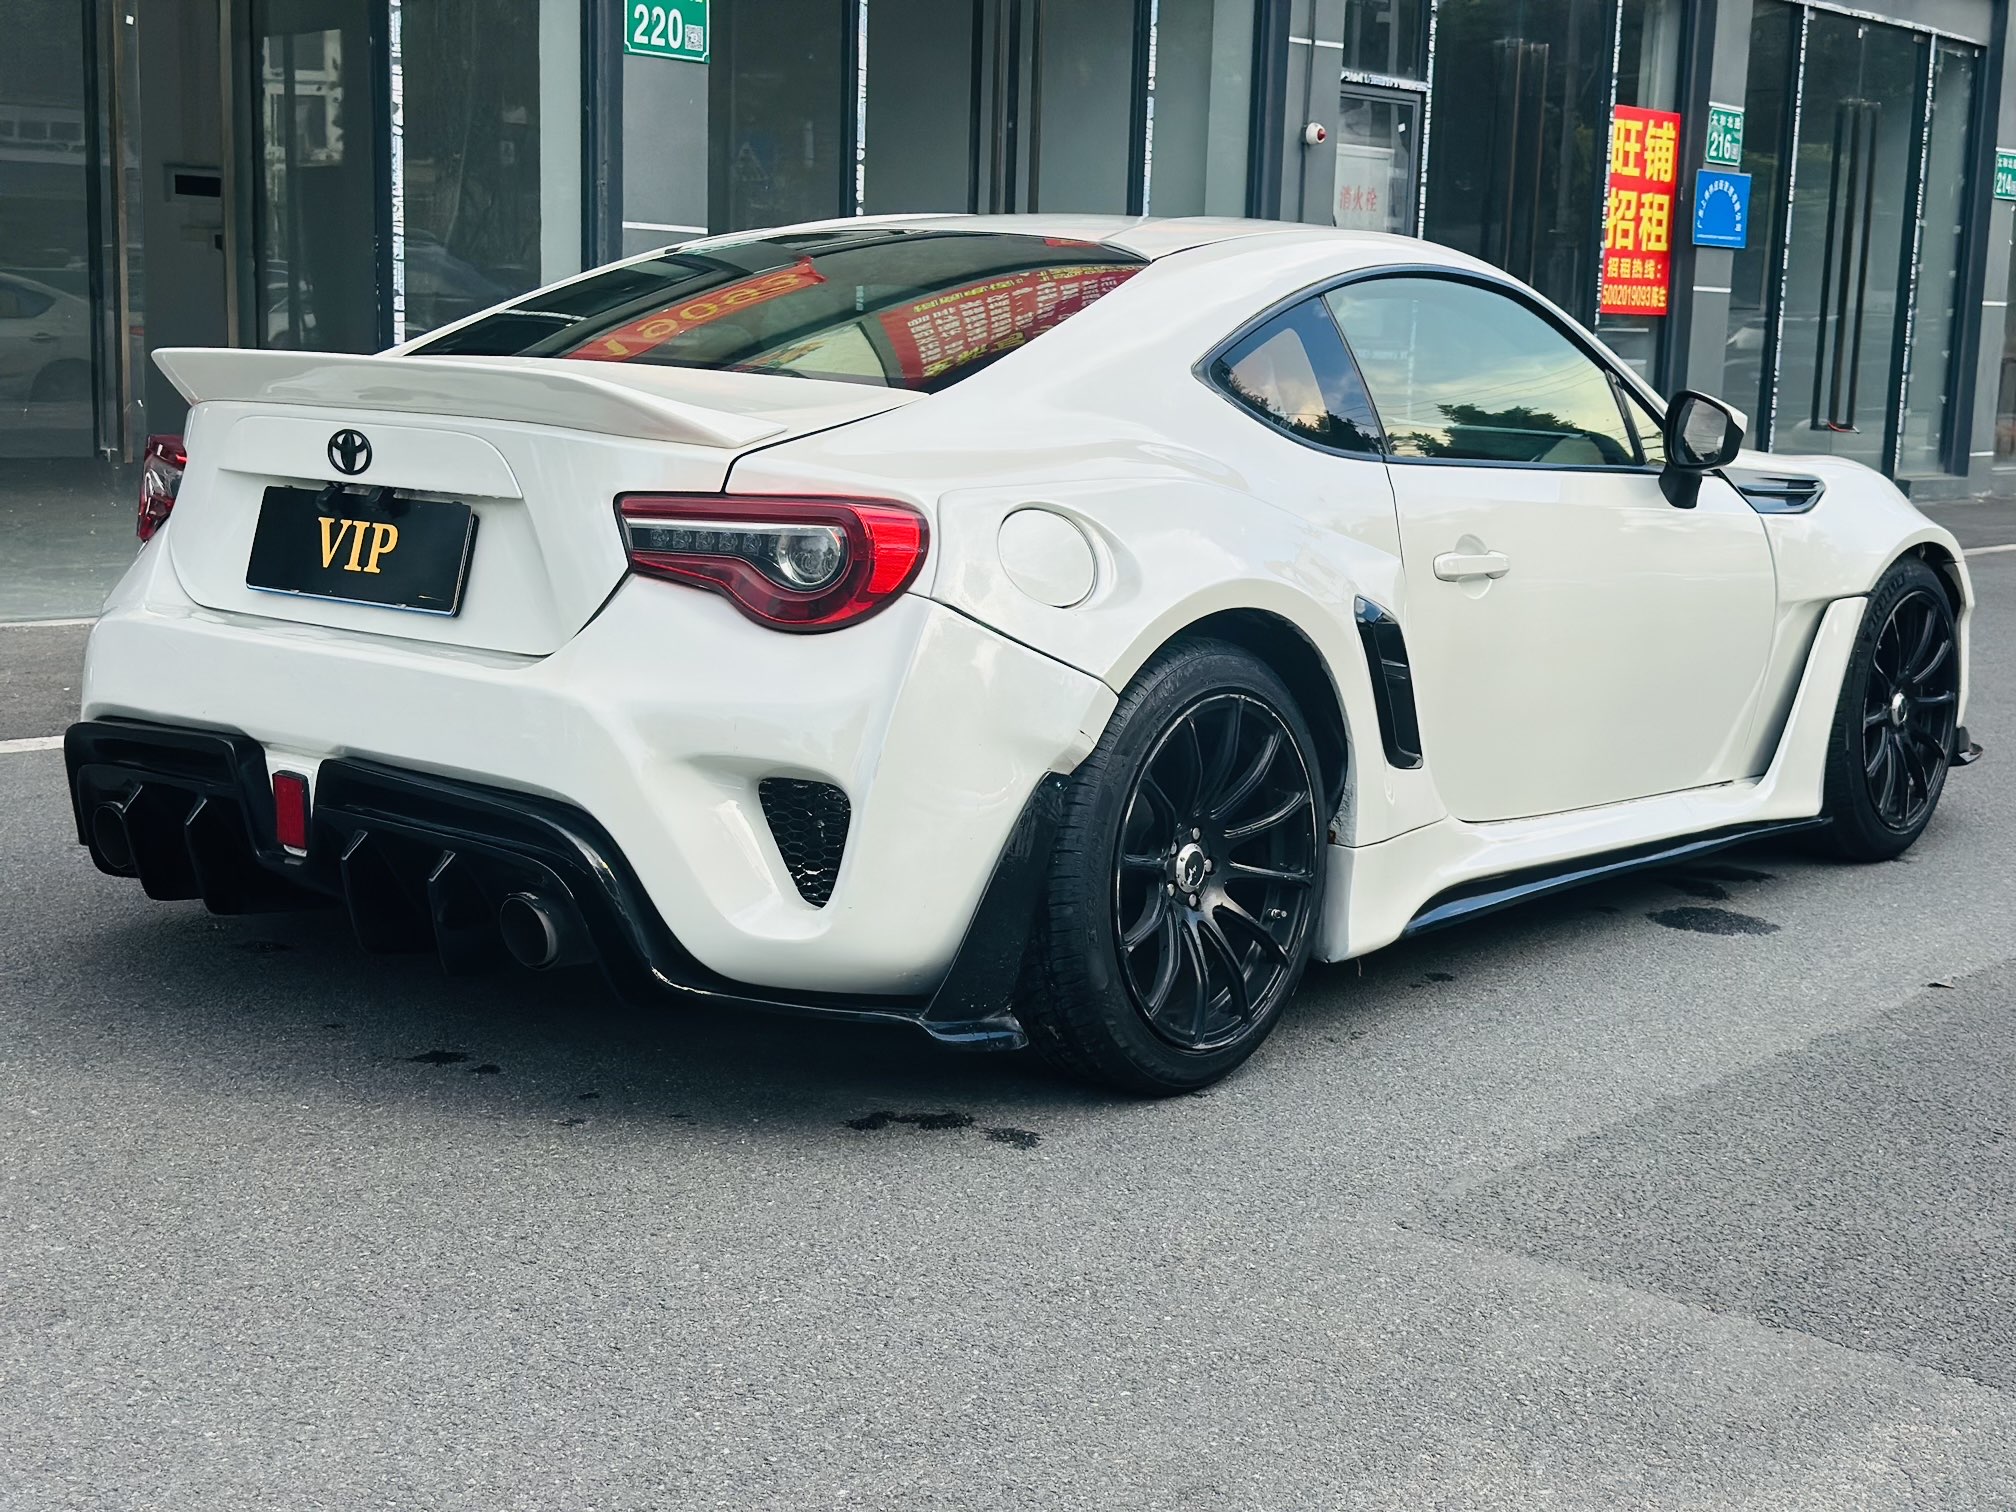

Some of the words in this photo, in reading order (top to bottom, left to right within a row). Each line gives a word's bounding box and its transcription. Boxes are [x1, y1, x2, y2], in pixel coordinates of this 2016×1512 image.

[633, 3, 683, 49] 220
[1610, 118, 1676, 182] 旺铺
[1709, 131, 1732, 159] 216
[1340, 185, 1376, 211] 消火栓
[1996, 172, 2012, 194] 214
[1605, 187, 1670, 252] 招租
[317, 516, 399, 574] VIP
